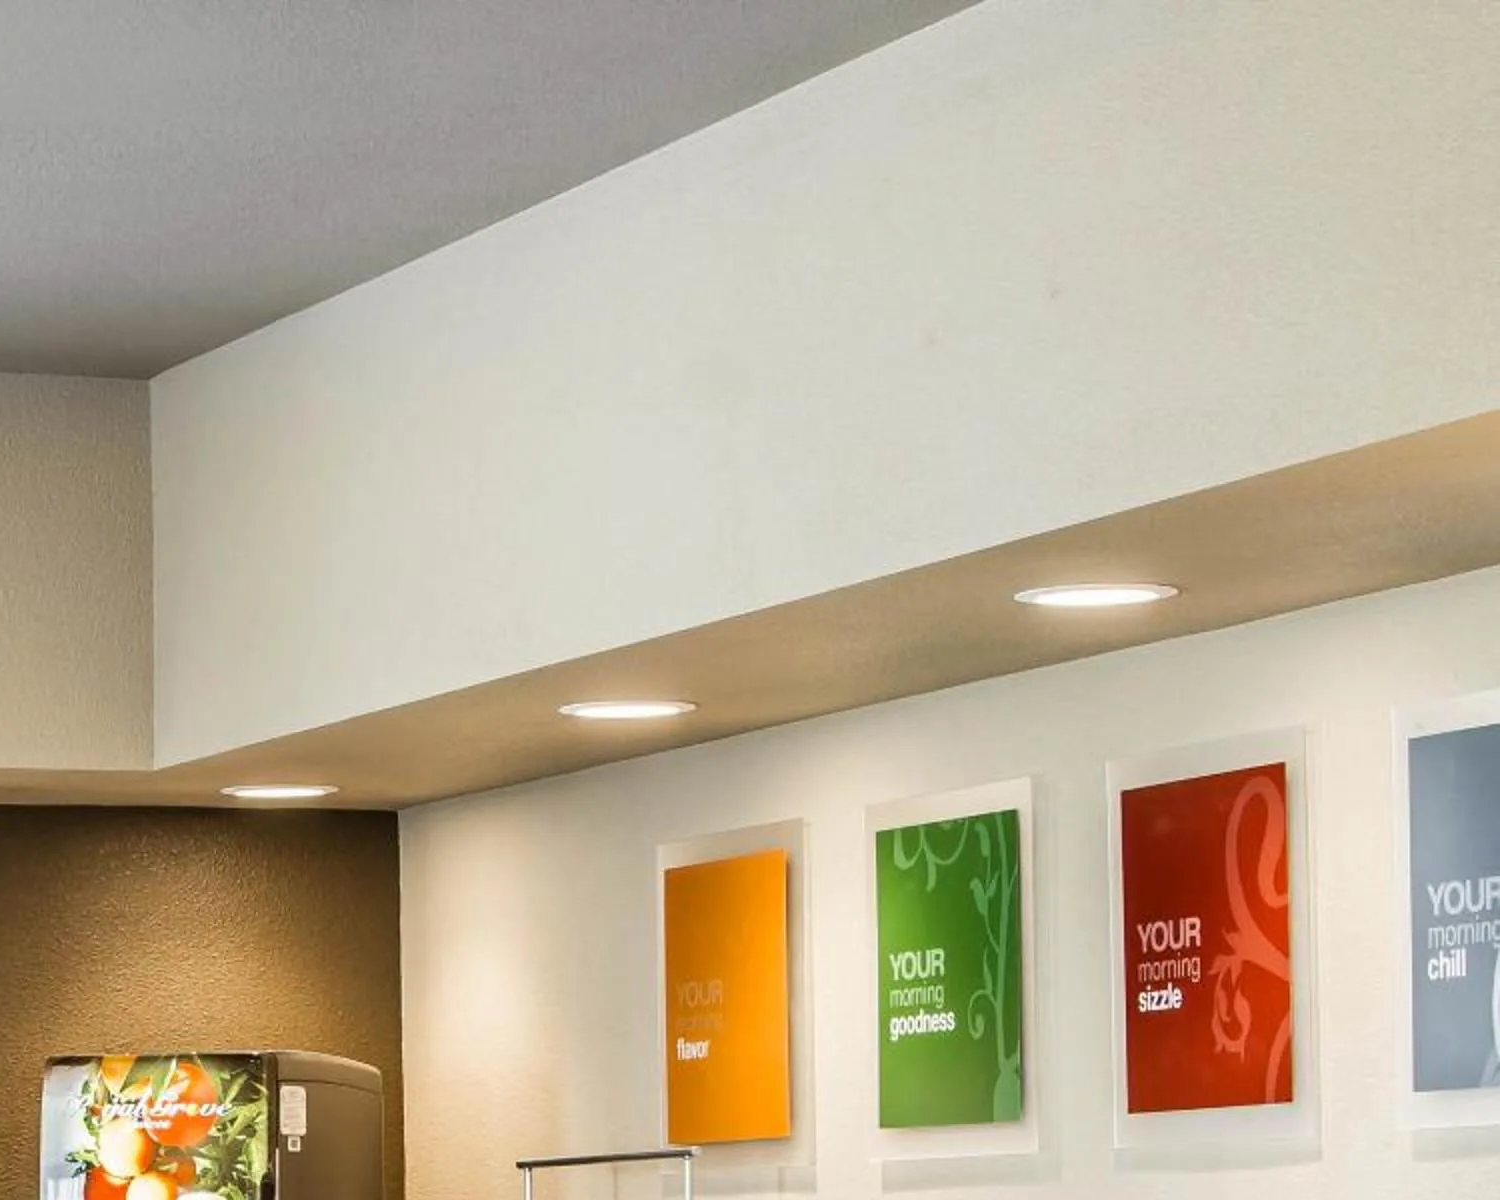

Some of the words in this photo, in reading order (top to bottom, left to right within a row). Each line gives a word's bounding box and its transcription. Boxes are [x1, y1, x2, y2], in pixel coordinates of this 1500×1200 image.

[1427, 876, 1500, 916] YOUR
[1136, 916, 1201, 953] YOUR
[1427, 914, 1500, 949] morning
[889, 947, 945, 980] YOUR
[1138, 952, 1201, 983] morning
[1427, 948, 1467, 981] chill
[890, 980, 945, 1009] morning
[1138, 982, 1182, 1012] sizzle
[889, 1007, 955, 1042] goodness
[677, 1037, 709, 1060] flavor
